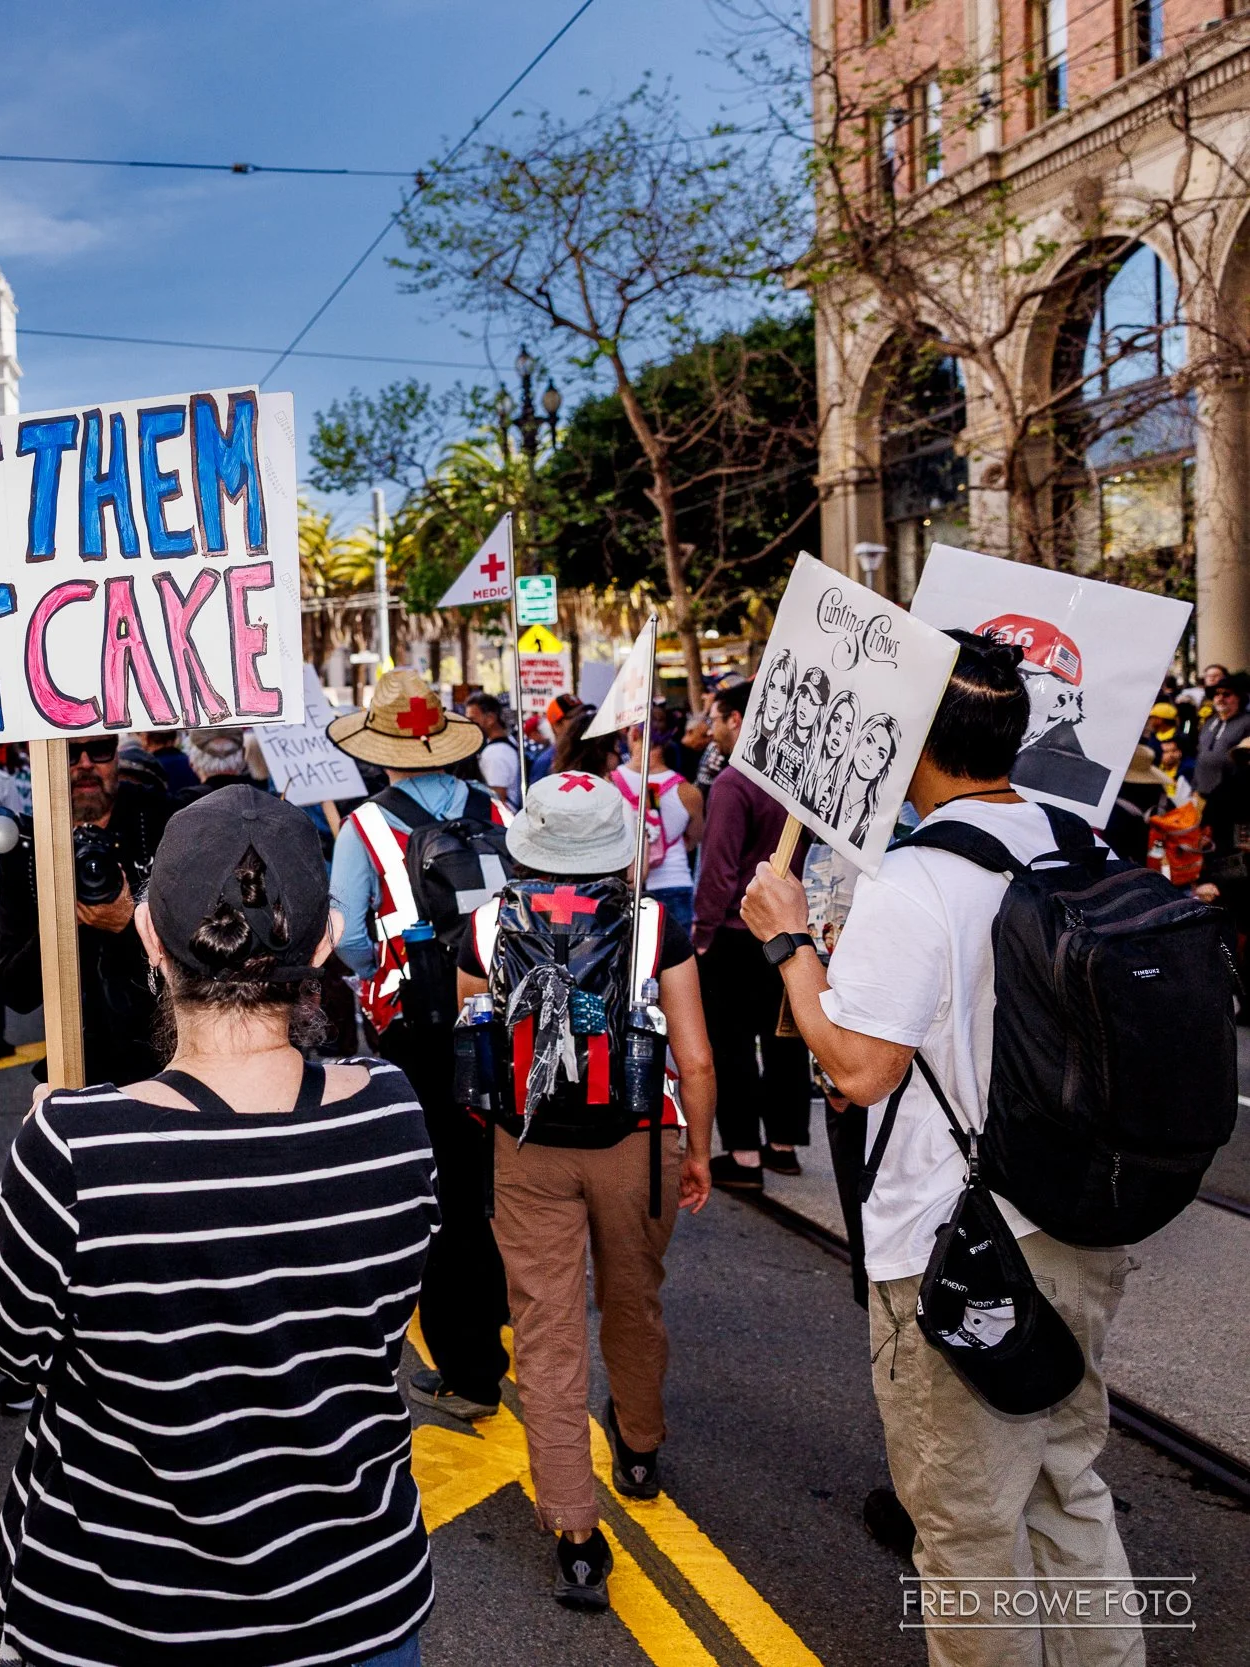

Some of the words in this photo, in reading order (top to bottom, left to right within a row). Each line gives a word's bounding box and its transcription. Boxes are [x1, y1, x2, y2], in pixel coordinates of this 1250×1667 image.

[16, 389, 269, 563] THEM
[473, 586, 508, 599] MEDIC
[24, 560, 283, 730] CAKE
[862, 614, 901, 669] Crows
[778, 741, 804, 769] POLICE
[779, 756, 795, 778] ICE
[284, 761, 349, 788] HATE
